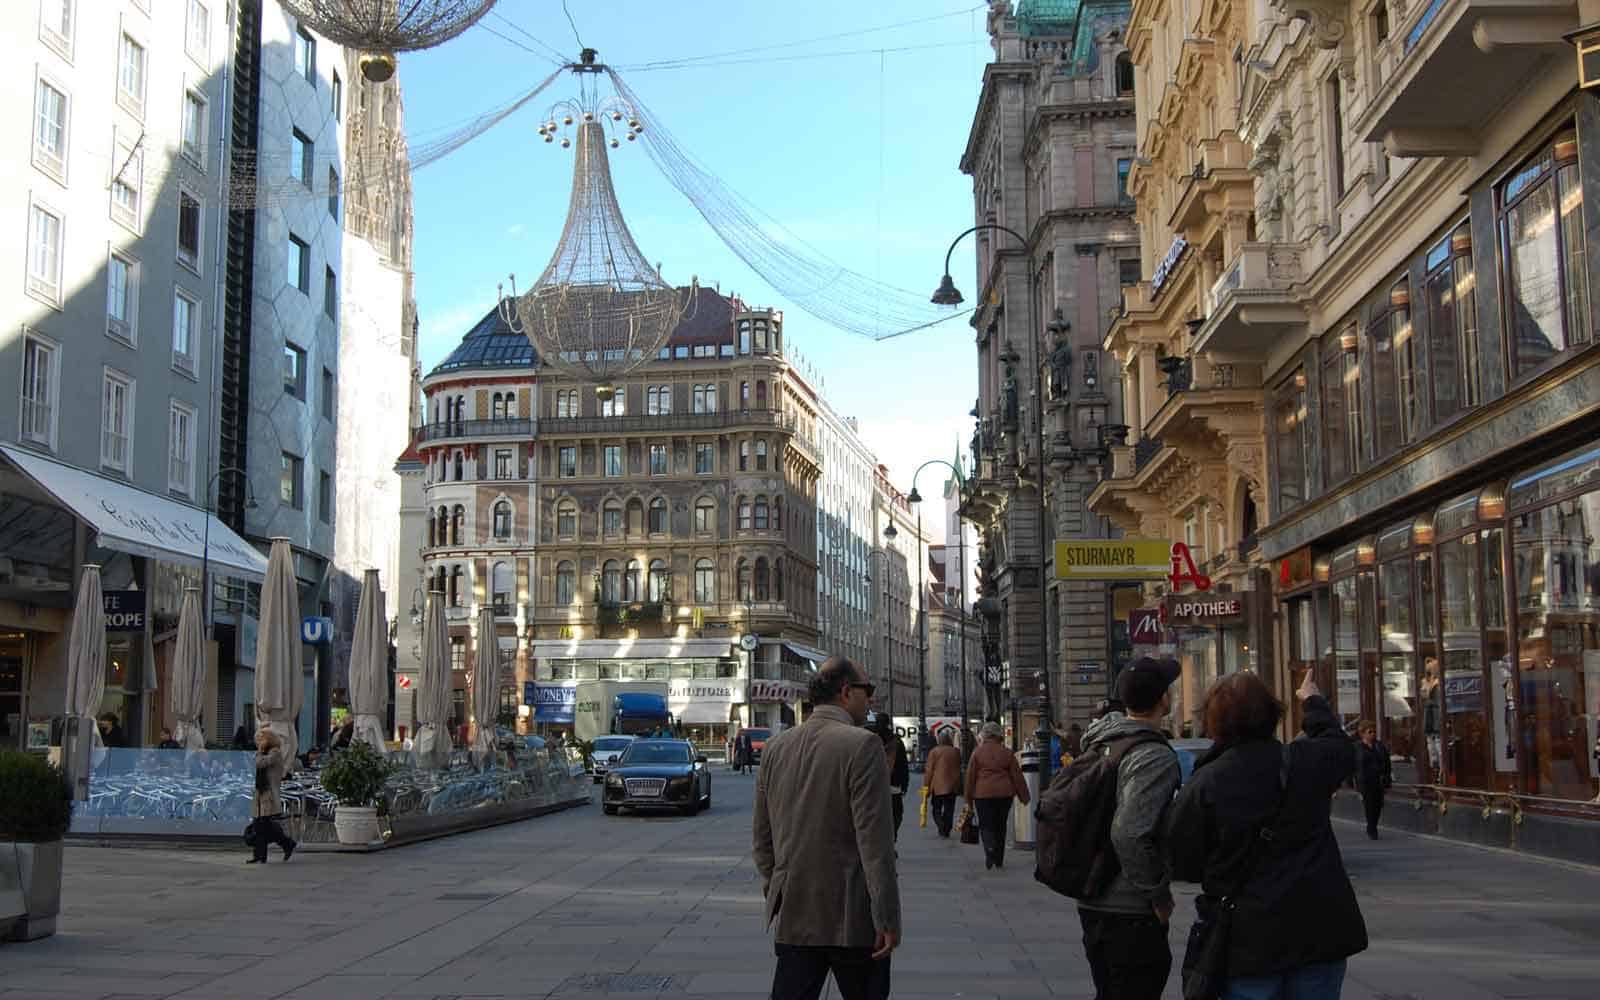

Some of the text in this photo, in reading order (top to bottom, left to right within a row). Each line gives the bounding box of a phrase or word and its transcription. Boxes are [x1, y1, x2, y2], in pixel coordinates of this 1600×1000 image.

[1066, 547, 1136, 566] STURMAYR
[104, 596, 120, 609] FE
[1174, 600, 1237, 617] APOTHEKE
[104, 613, 144, 626] ROPE
[304, 622, 321, 641] U
[669, 687, 736, 697] ONDITOREI
[895, 726, 917, 738] DP
